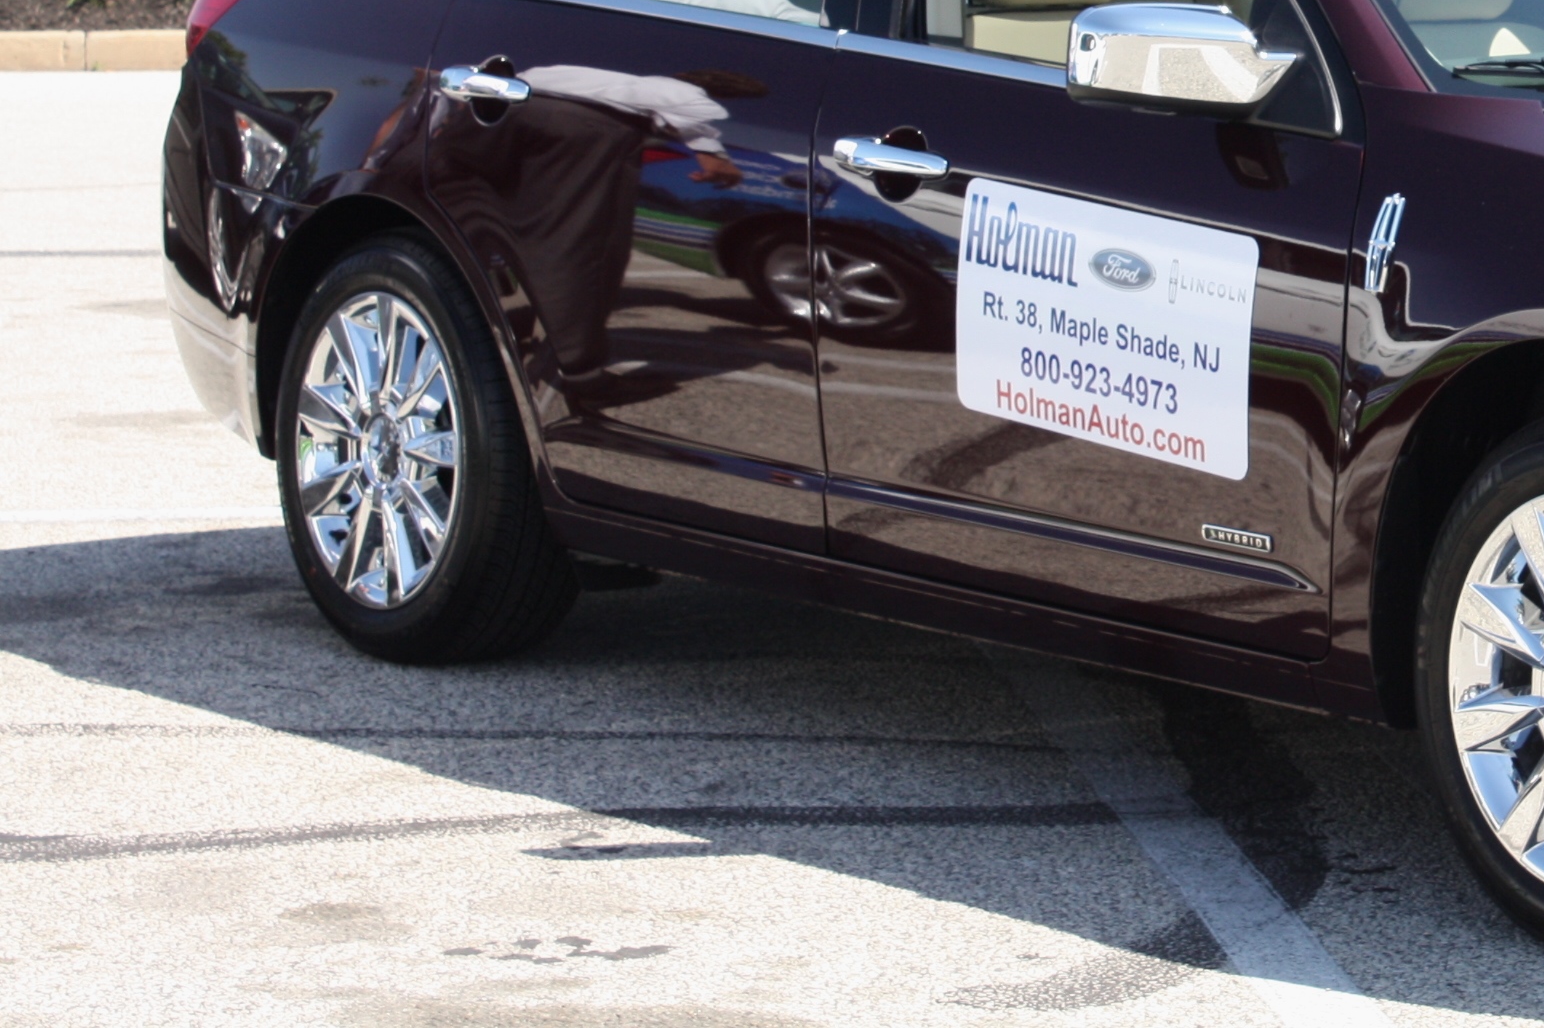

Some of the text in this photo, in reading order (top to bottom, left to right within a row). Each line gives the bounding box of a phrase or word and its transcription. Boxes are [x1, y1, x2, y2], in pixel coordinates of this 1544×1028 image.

[965, 193, 1078, 287] Holman
[1101, 253, 1141, 285] Ford
[1179, 275, 1247, 304] LINCOLN
[983, 291, 1220, 373] Rt. 38, Maple Shade, NJ
[1021, 347, 1178, 414] 800-923-4973
[996, 379, 1206, 462] HolmanAuto.com
[1218, 531, 1263, 548] HYBRID
